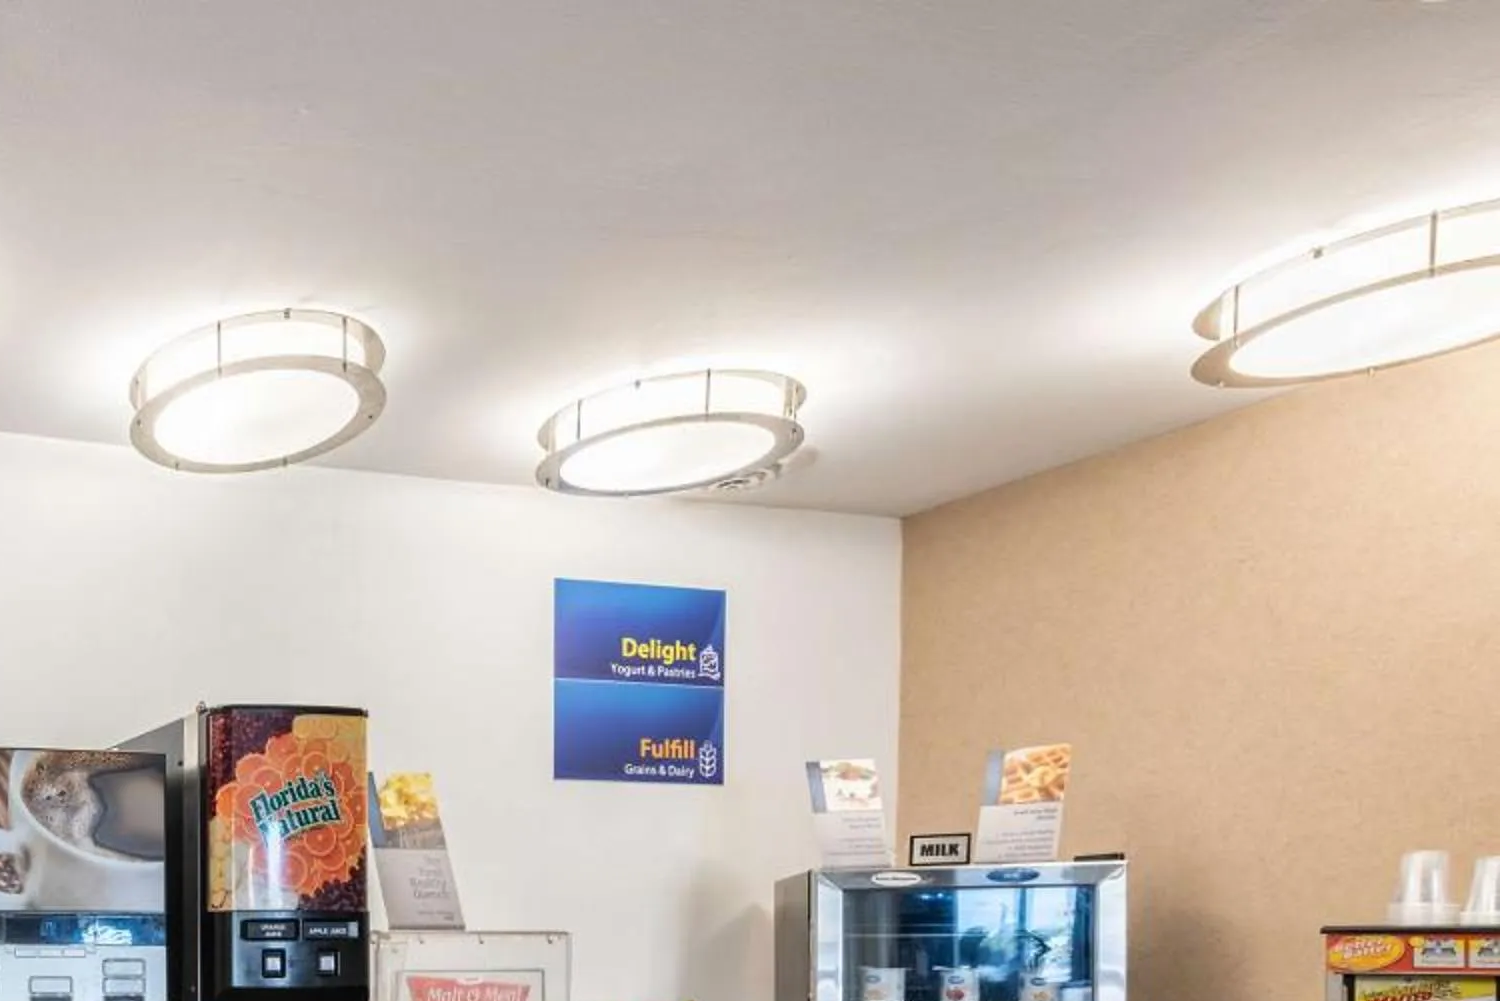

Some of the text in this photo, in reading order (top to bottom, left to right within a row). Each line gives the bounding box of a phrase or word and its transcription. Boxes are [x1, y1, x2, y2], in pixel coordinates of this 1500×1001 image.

[621, 636, 697, 666] Delight
[611, 662, 646, 678] Yogurt
[657, 665, 696, 679] Pastries
[640, 738, 696, 760] Fulfill
[624, 762, 657, 775] Grains
[667, 765, 695, 779] Dairy
[249, 770, 336, 822] Florida's
[919, 842, 960, 858] MILK
